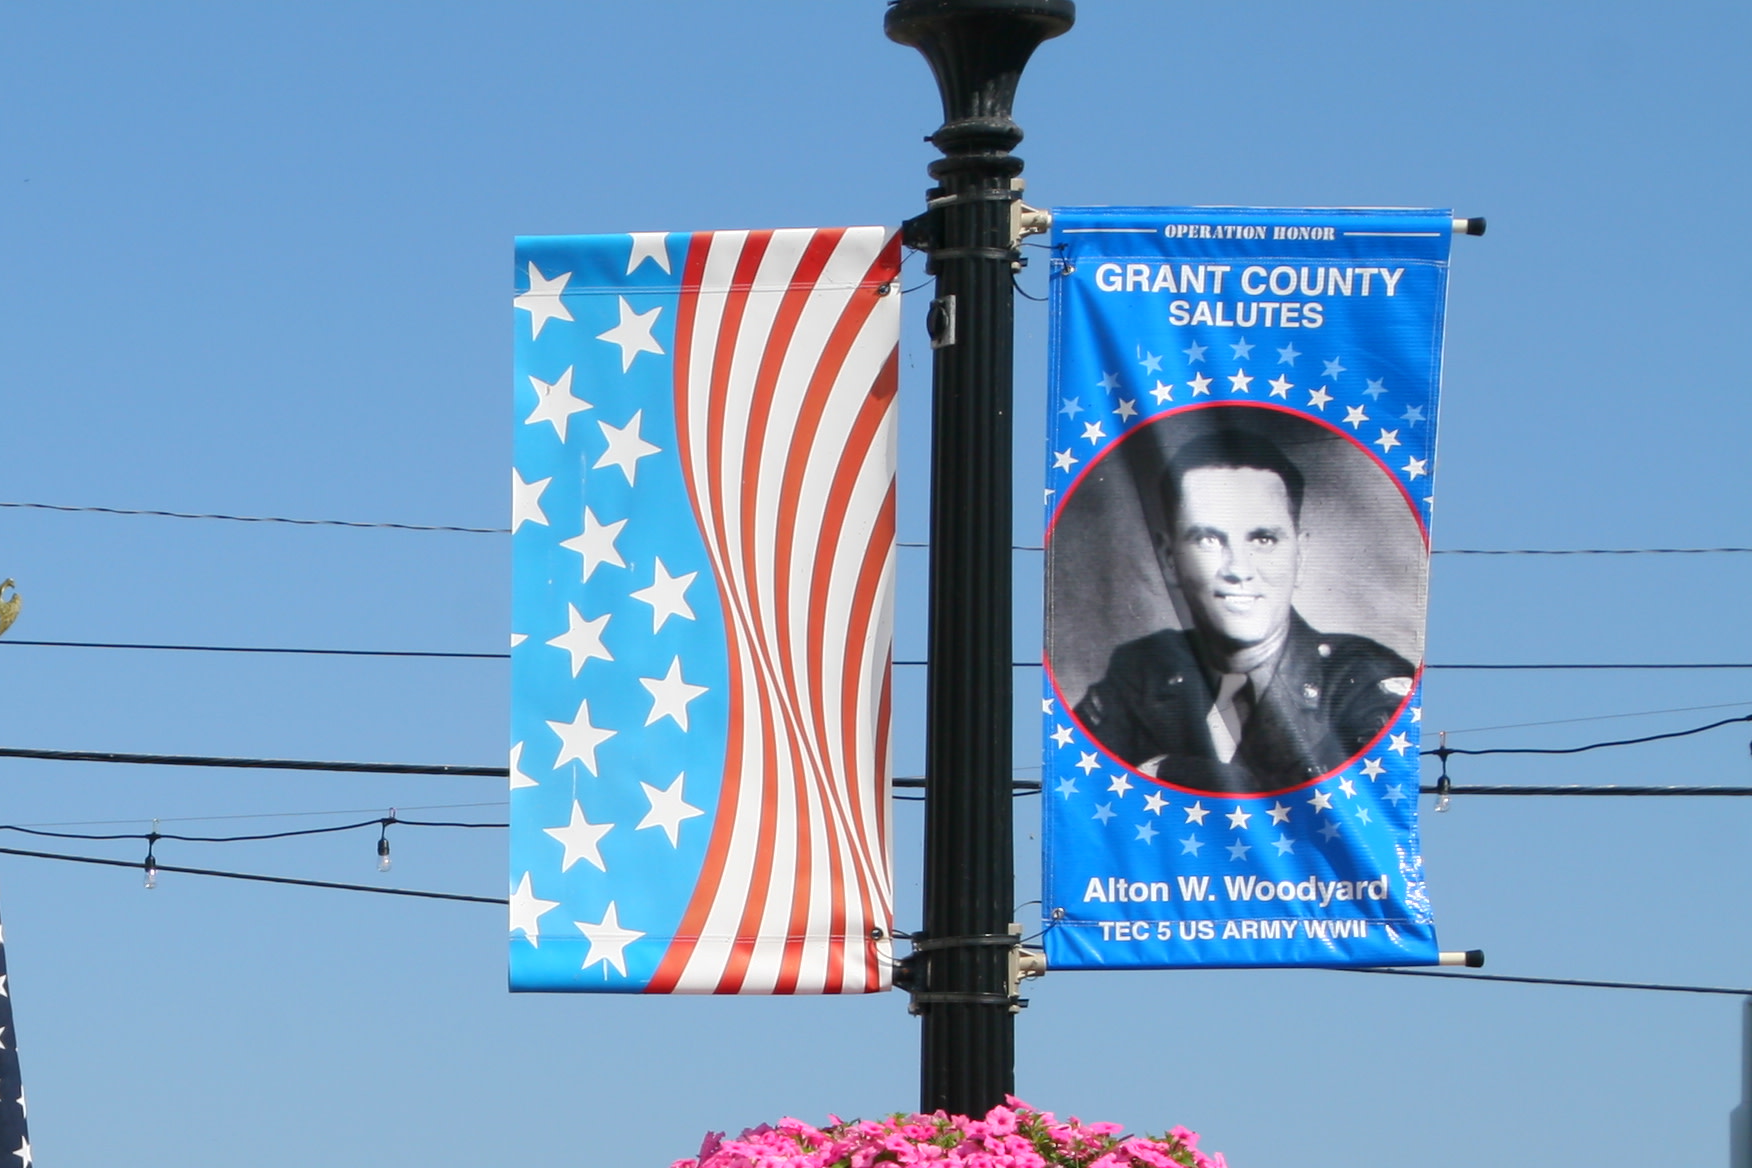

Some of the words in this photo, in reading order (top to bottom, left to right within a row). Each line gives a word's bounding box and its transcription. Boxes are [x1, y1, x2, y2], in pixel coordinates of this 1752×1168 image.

[1164, 224, 1266, 240] OPERATION
[1273, 226, 1336, 241] HONOR
[1095, 263, 1231, 294] GRANT
[1241, 266, 1405, 297] COUNTY
[1169, 300, 1324, 328] SALUTES
[1083, 876, 1169, 902] Alton
[1177, 876, 1216, 902] W.
[1224, 875, 1388, 907] Woodyard
[1100, 921, 1149, 942] TEC
[1156, 921, 1171, 941] 5
[1180, 921, 1216, 941] US
[1222, 920, 1299, 940] ARMY
[1303, 919, 1368, 939] WWII
